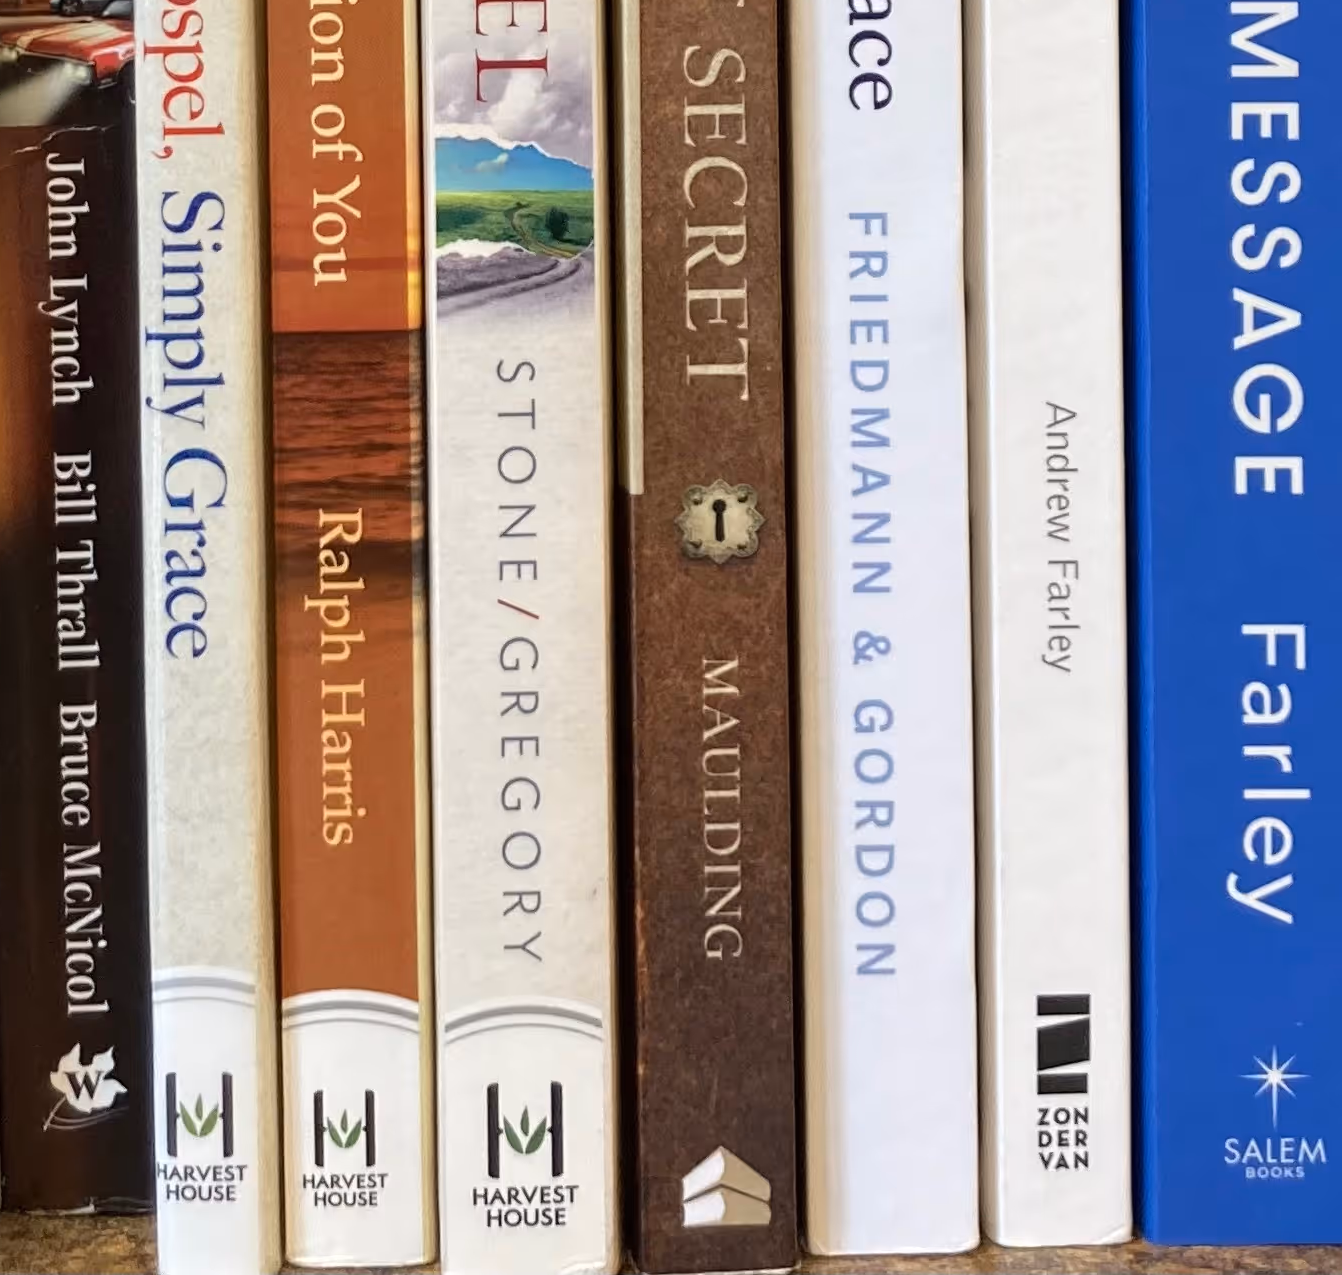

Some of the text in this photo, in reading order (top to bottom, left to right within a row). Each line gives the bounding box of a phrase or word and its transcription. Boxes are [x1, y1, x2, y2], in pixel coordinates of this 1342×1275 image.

[312, 103, 364, 167] of
[312, 172, 364, 287] You
[682, 44, 748, 403] SECRET
[1230, 1, 1304, 495] MESSAGE
[145, 188, 228, 429] Simply
[161, 446, 227, 659] Grace
[1041, 400, 1078, 675] Andrew Farley
[37, 152, 109, 1018] John Lynch Bill Thrall Bruce McNicol
[847, 211, 895, 978] FRIEDMANN & GORDON
[303, 508, 365, 847] Ralph Harris
[1226, 622, 1312, 925] Farley
[701, 655, 742, 962] MAULDING
[1037, 1107, 1088, 1125] ZON
[1038, 1130, 1088, 1148] DER
[156, 1162, 247, 1182] HARVEST
[301, 1173, 388, 1190] HARVEST
[1038, 1152, 1088, 1169] VAN
[1224, 1137, 1327, 1165] SALEM
[1245, 1167, 1304, 1179] BOOKS
[165, 1182, 237, 1202] HOUSE
[313, 1189, 377, 1208] HOUSE
[471, 1185, 578, 1209] HARVEST
[485, 1208, 566, 1228] HOUSE
